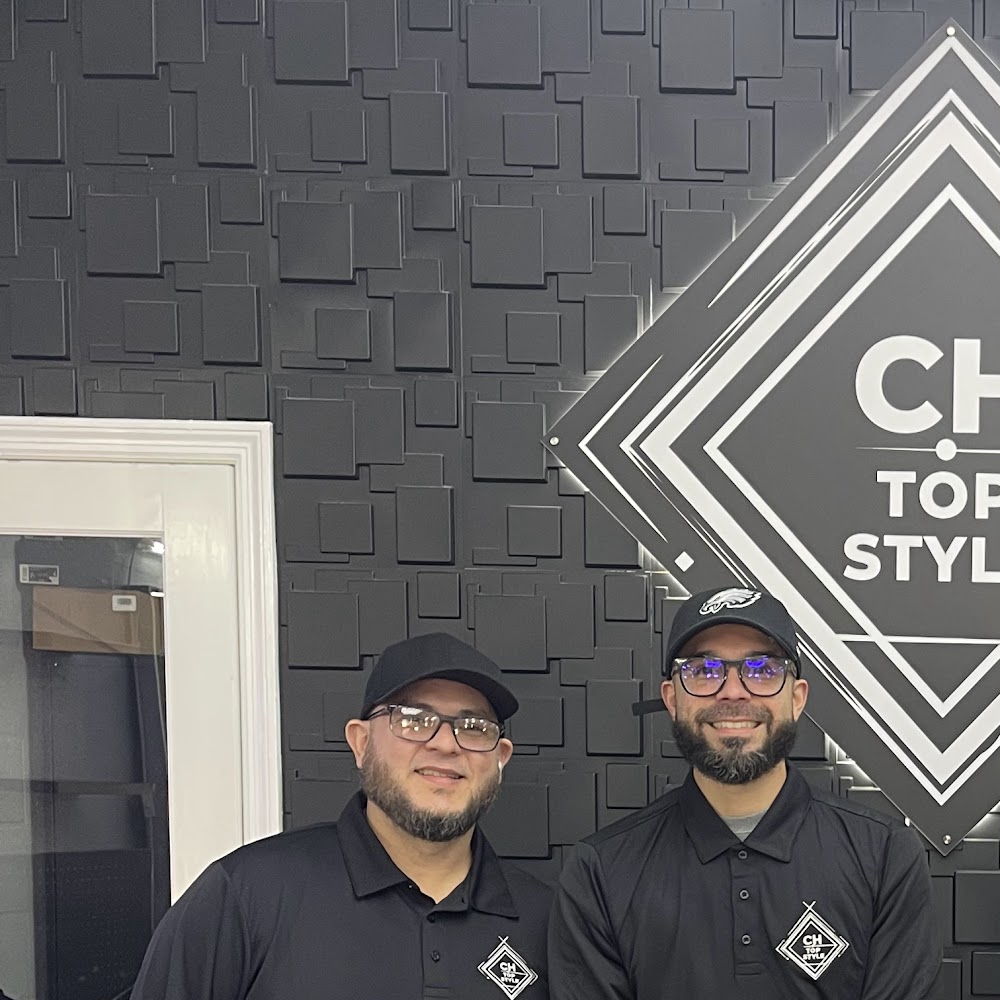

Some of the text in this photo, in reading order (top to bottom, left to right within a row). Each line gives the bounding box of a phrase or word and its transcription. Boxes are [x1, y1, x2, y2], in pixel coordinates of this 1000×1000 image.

[802, 934, 822, 946] CH
[805, 947, 821, 955] TOP
[802, 953, 825, 961] STYLE
[500, 962, 516, 973] CH
